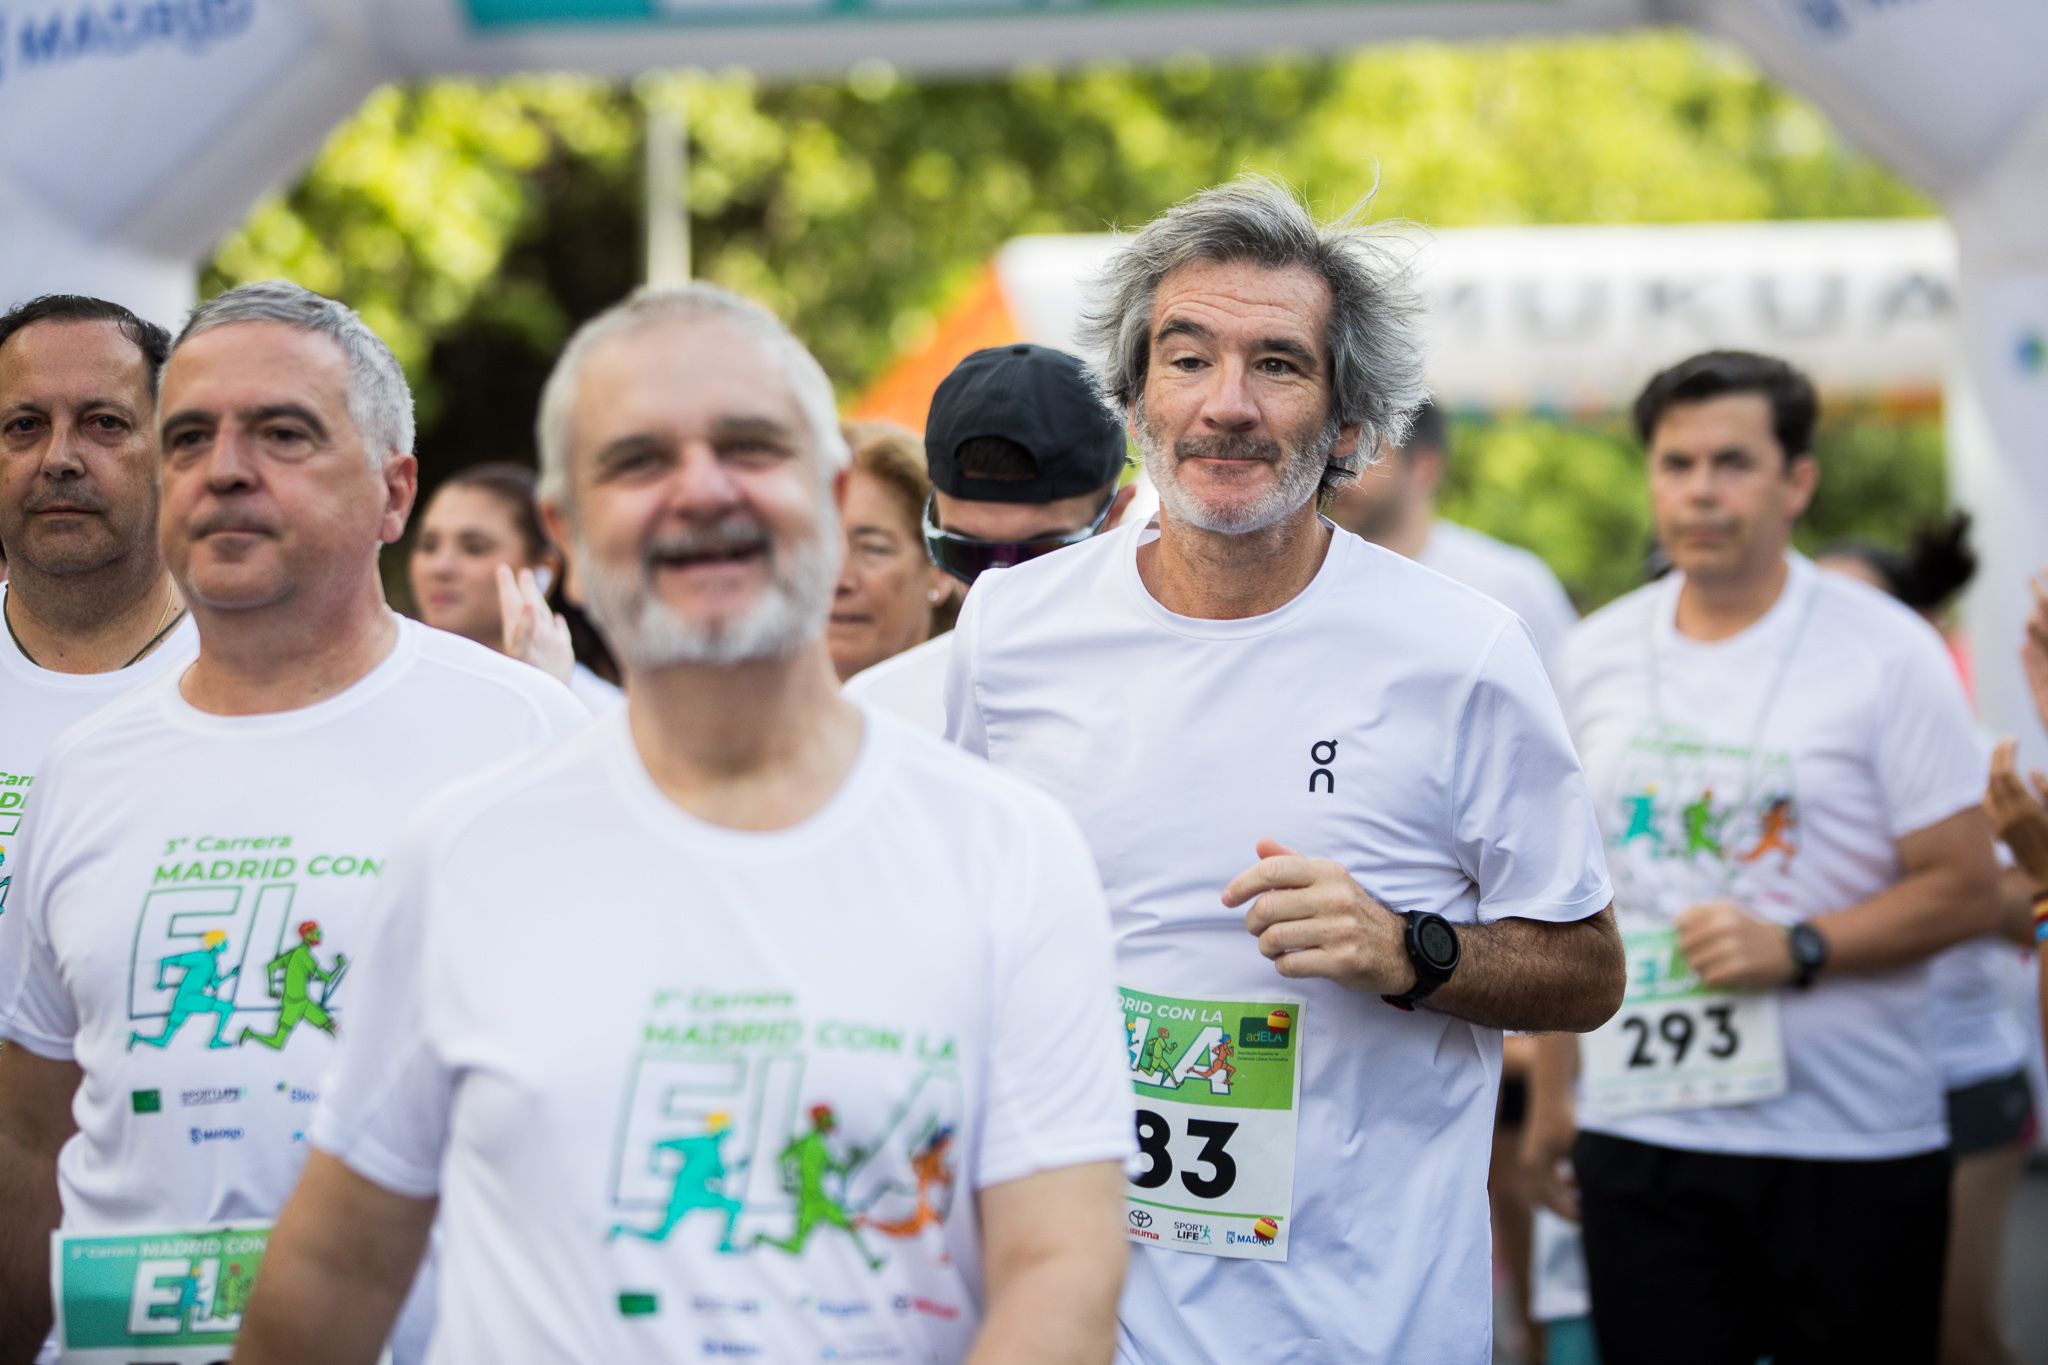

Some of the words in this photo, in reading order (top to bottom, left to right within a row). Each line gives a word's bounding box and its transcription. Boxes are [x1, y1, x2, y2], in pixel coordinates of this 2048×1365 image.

[195, 834, 293, 852] Carrera
[153, 857, 298, 885] MADRID
[1157, 1004, 1196, 1021] CON
[1200, 1008, 1223, 1024] LA
[644, 1017, 804, 1047] MADRID
[817, 1018, 904, 1050] CON
[1246, 1031, 1282, 1042] adELA
[1621, 1004, 1740, 1068] 293
[1127, 1108, 1240, 1199] 83
[1173, 1221, 1203, 1233] SPORT
[1177, 1230, 1199, 1241] LIFE
[139, 1236, 222, 1257] MADRID
